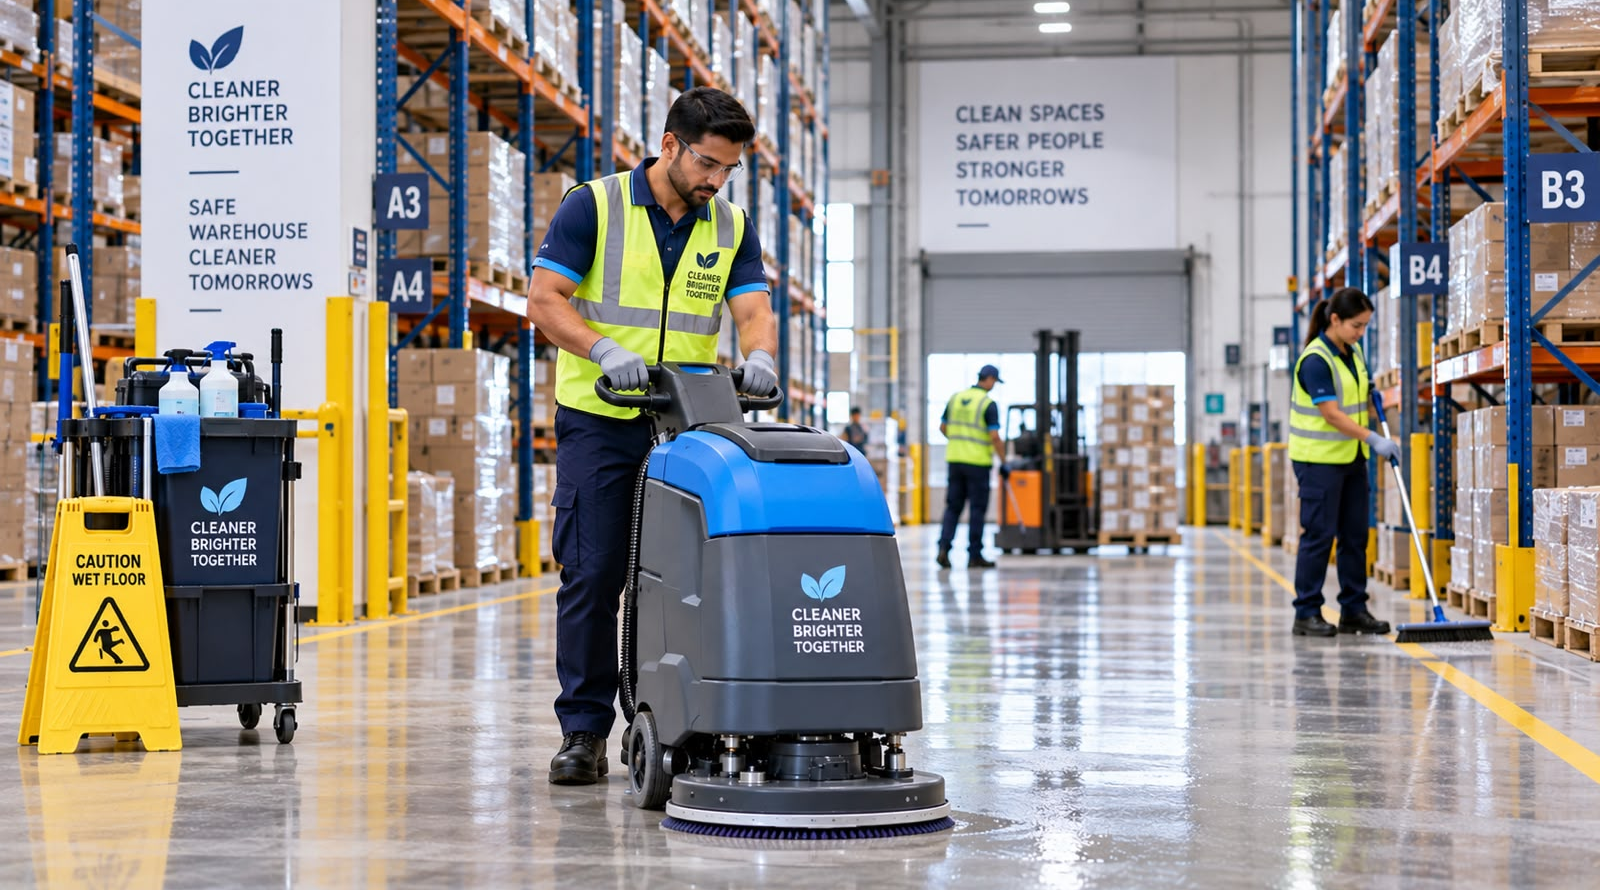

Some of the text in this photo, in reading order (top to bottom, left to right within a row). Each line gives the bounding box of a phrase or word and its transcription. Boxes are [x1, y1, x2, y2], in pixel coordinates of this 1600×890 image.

[188, 80, 280, 99] CLEANER
[188, 104, 288, 123] BRIGHTER
[955, 103, 1105, 123] CLEAN SPACES
[188, 128, 294, 147] TOGETHER
[956, 131, 1104, 151] SAFER PEOPLE
[956, 160, 1065, 179] STRONGER
[956, 187, 1089, 206] TOMORROWS
[1541, 169, 1586, 209] B3
[189, 198, 236, 216] SAFE
[387, 186, 421, 219] A3
[189, 222, 308, 241] WAREHOUSE
[189, 248, 276, 266] CLEANER
[1409, 254, 1443, 286] B4
[189, 272, 313, 291] TOMORROWS
[390, 270, 424, 303] A4
[191, 521, 257, 534] CLEANER
[191, 538, 257, 551] BRIGHTER
[75, 554, 141, 569] CAUTION
[191, 554, 257, 567] TOGETHER
[72, 572, 146, 586] WET FLOOR
[791, 607, 861, 621] CLEANER
[793, 624, 863, 638] BRIGHTER
[794, 640, 865, 654] TOGETHER
